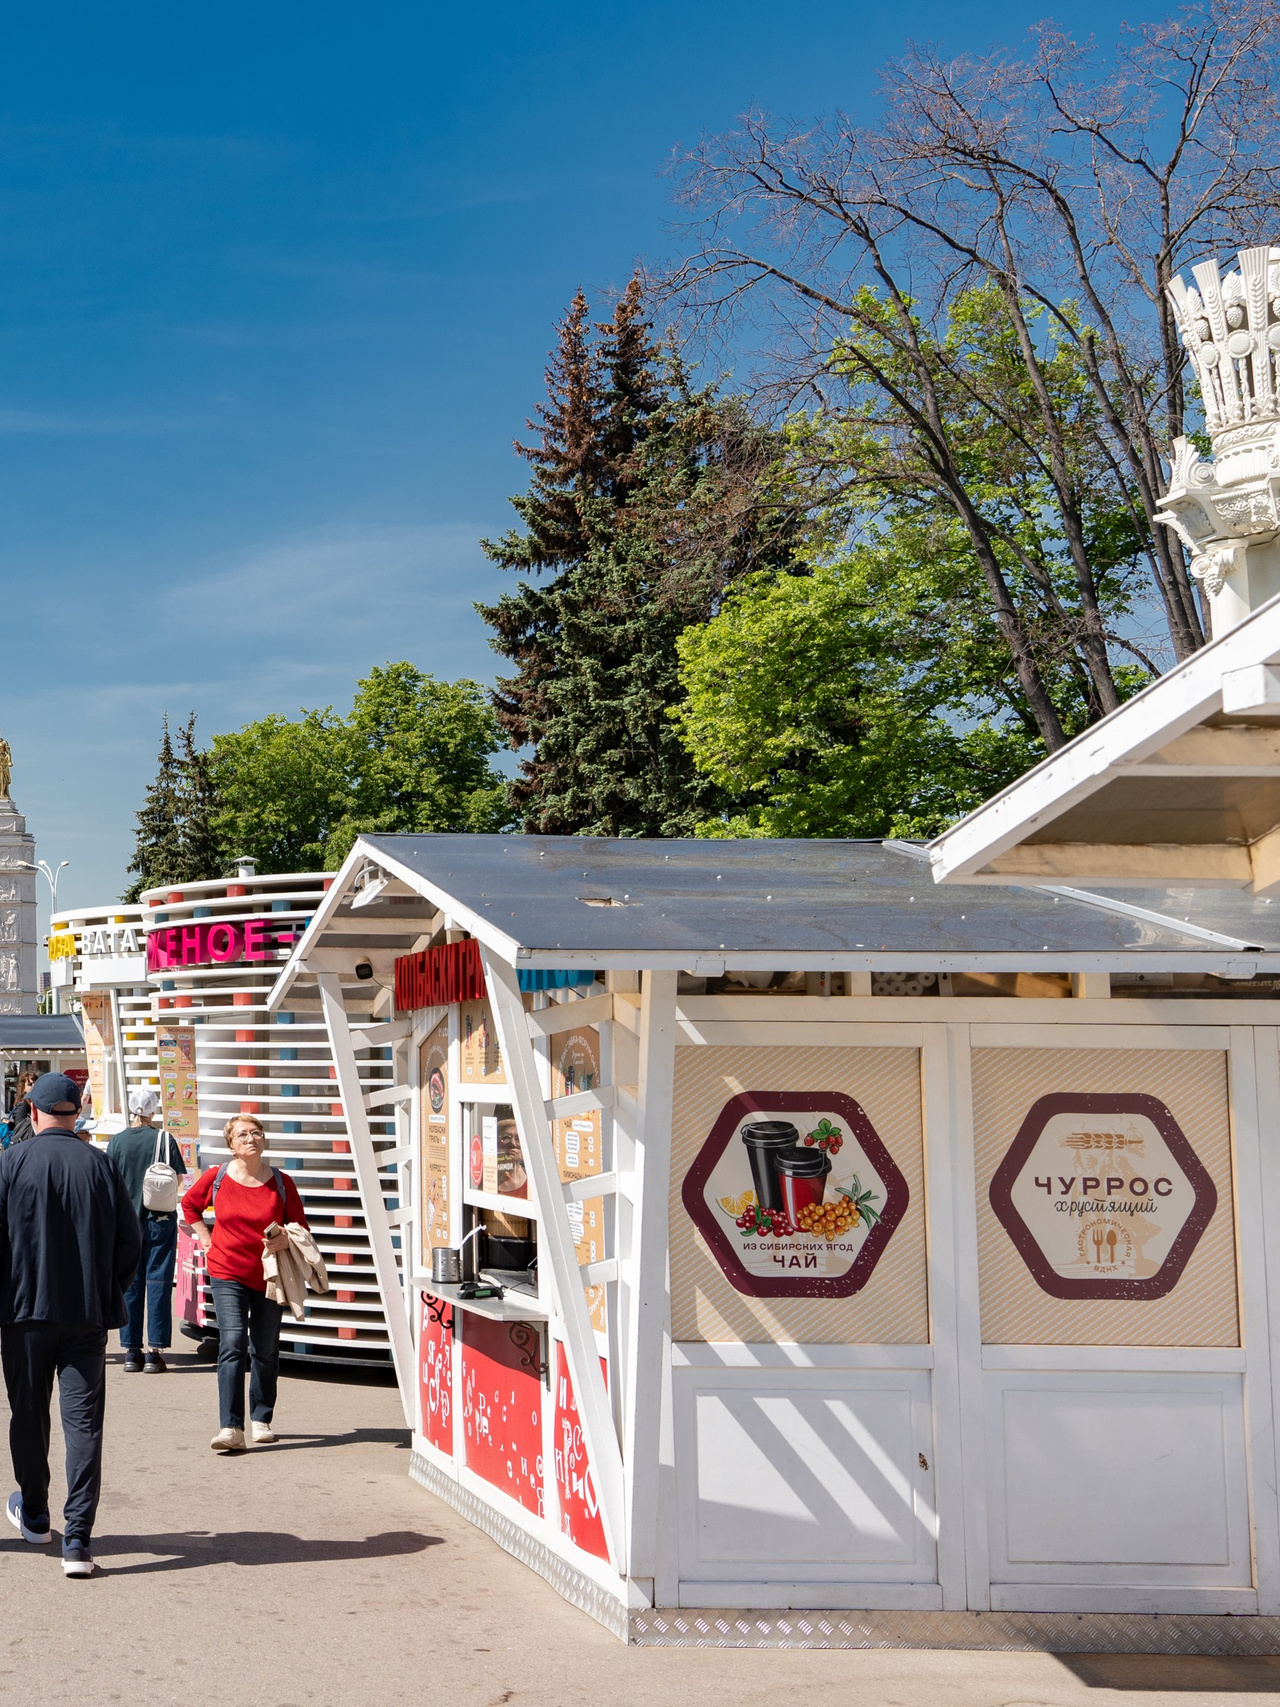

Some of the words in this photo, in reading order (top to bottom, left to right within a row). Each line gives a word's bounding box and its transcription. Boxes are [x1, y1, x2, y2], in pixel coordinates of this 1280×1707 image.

[81, 928, 139, 954] ВАТА
[394, 942, 457, 1011] КОЛБАСКИ
[1034, 1176, 1173, 1197] ЧУРРОС
[1054, 1197, 1158, 1217] хрустящий
[743, 1242, 757, 1250] ИЗ
[760, 1242, 823, 1251] СИБИРСКИХ
[826, 1243, 854, 1252] ЯГОД
[1077, 1218, 1132, 1258] ГАСТРОНОМИЧЕСКАЯ
[773, 1252, 818, 1269] ЧАЙ
[1093, 1264, 1118, 1273] ВДНХ
